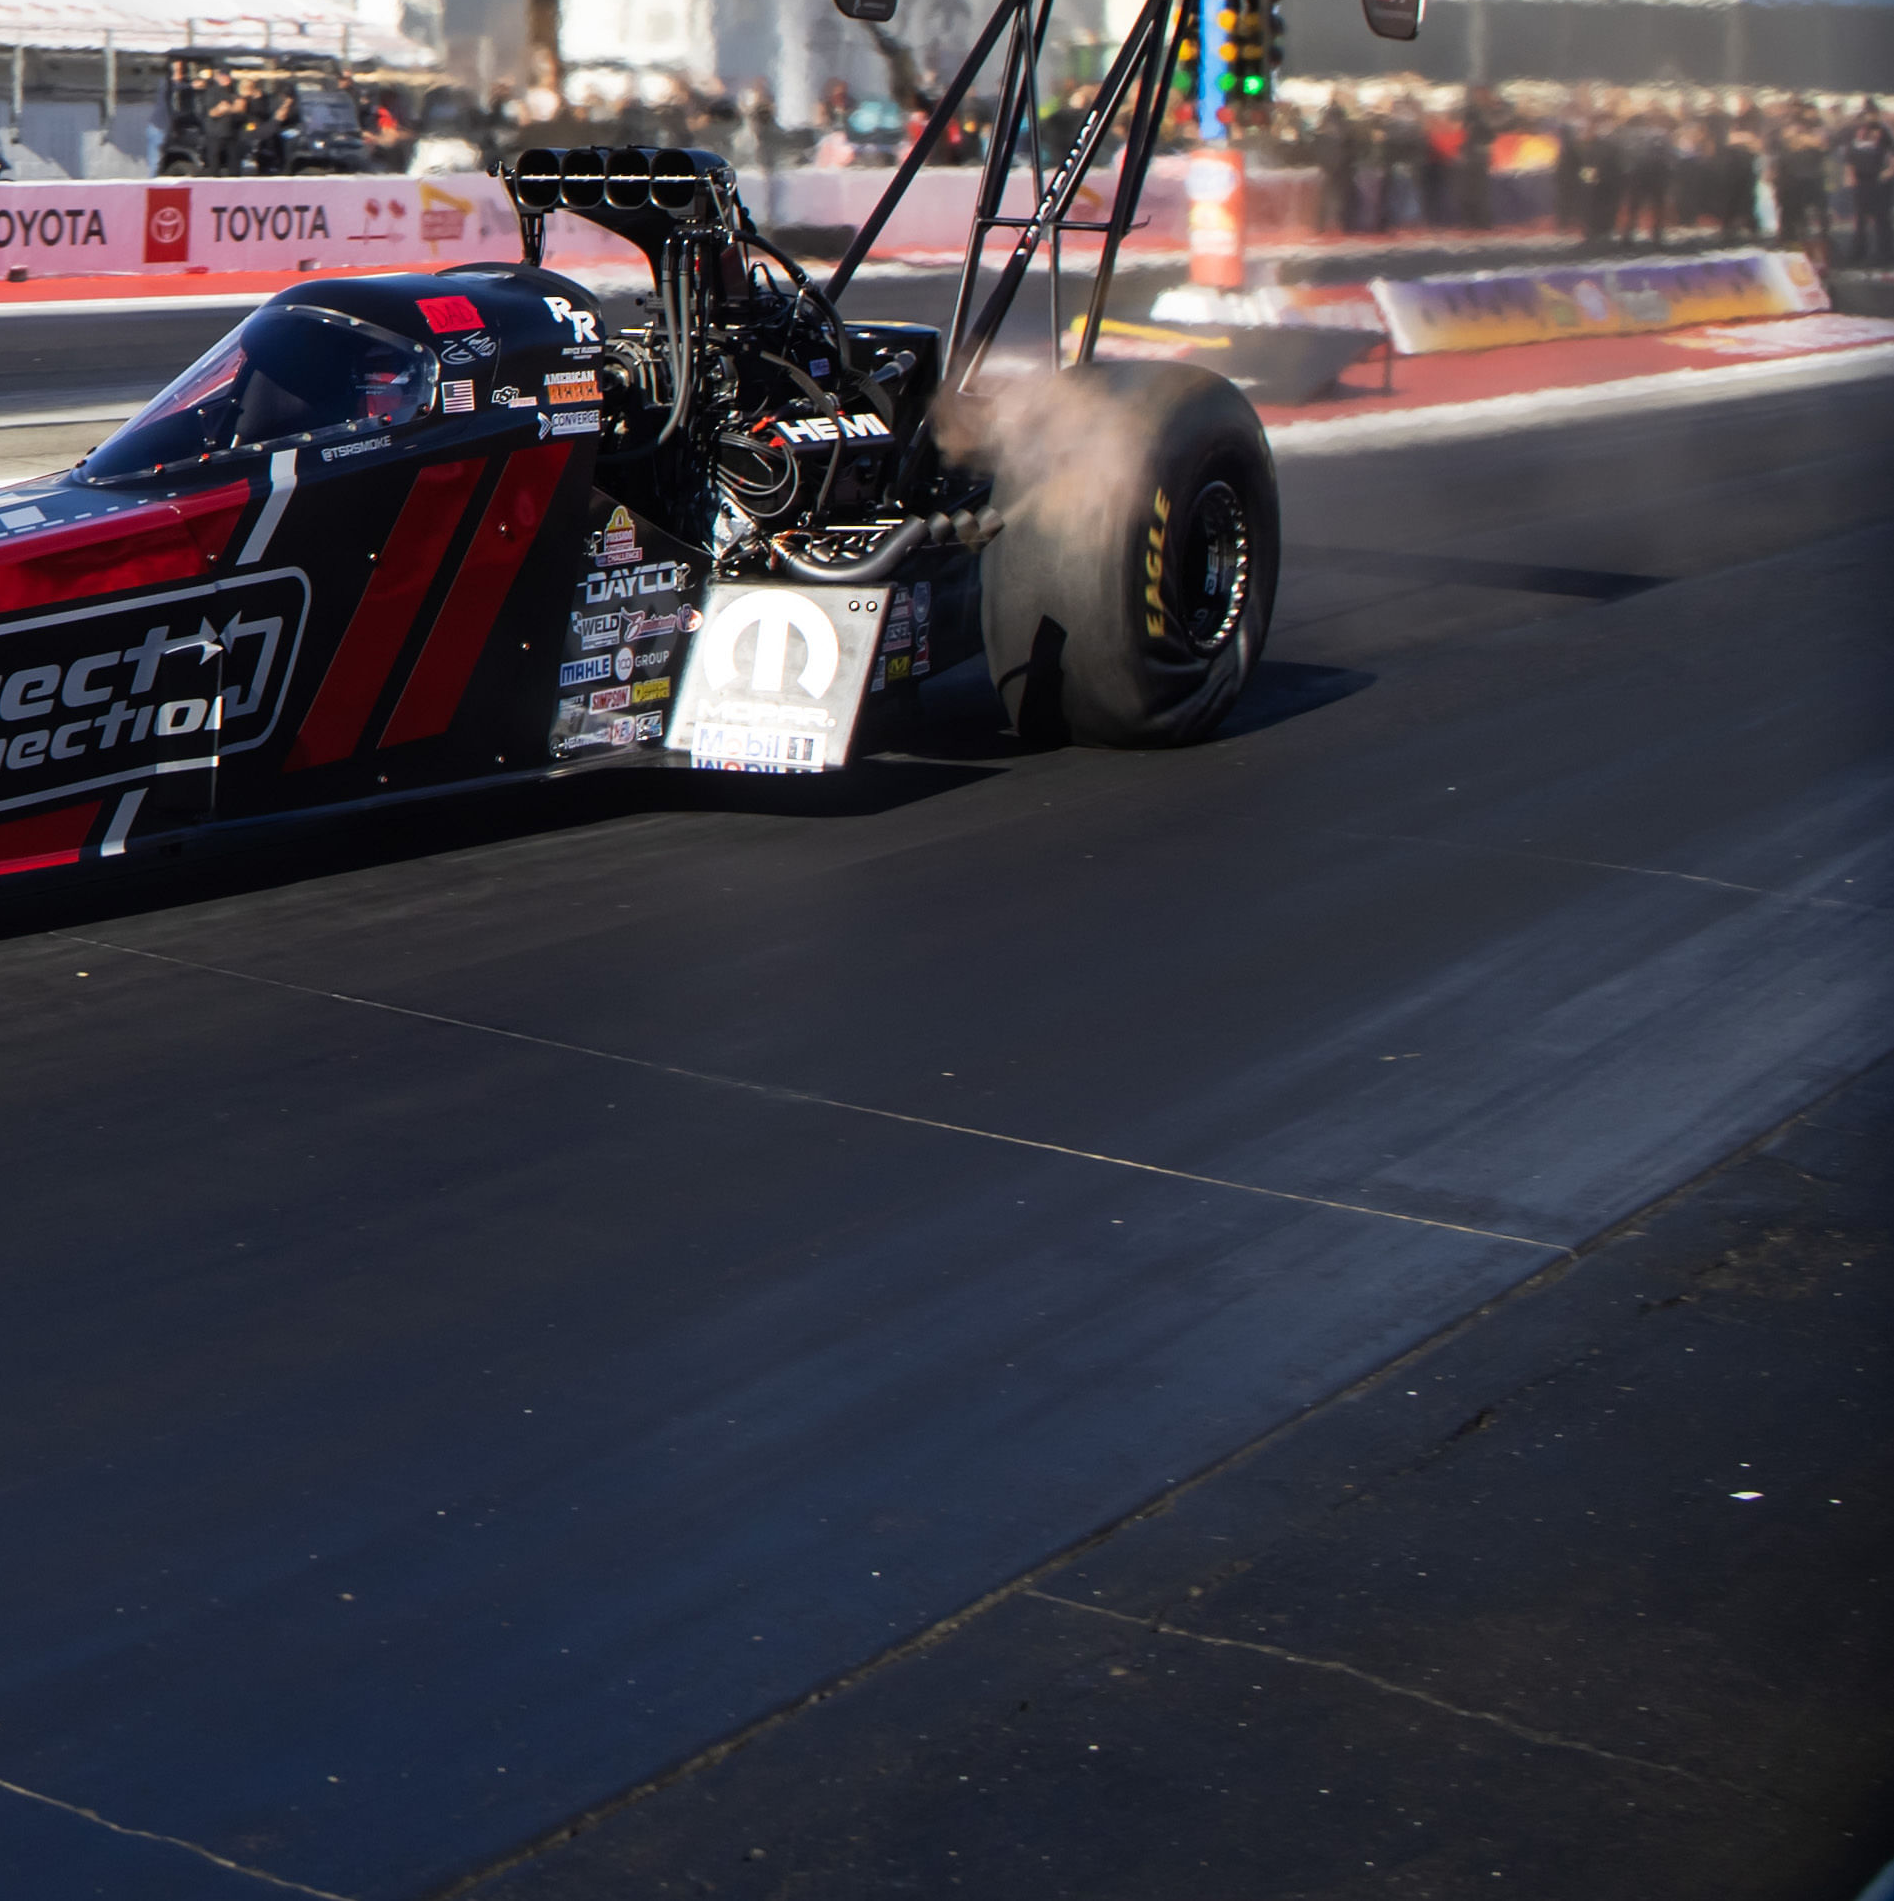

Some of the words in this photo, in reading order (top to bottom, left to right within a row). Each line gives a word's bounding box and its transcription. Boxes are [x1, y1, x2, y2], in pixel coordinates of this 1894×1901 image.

[211, 204, 331, 242] TOYOTA
[553, 411, 600, 427] CONVERGE
[776, 413, 891, 444] HEMI
[1146, 486, 1171, 638] EAGLE
[586, 560, 678, 604] DAYCO
[581, 613, 621, 637] WELD
[561, 657, 611, 685] MAHLE
[635, 650, 671, 668] GROUP
[591, 686, 631, 712] SIMPSON
